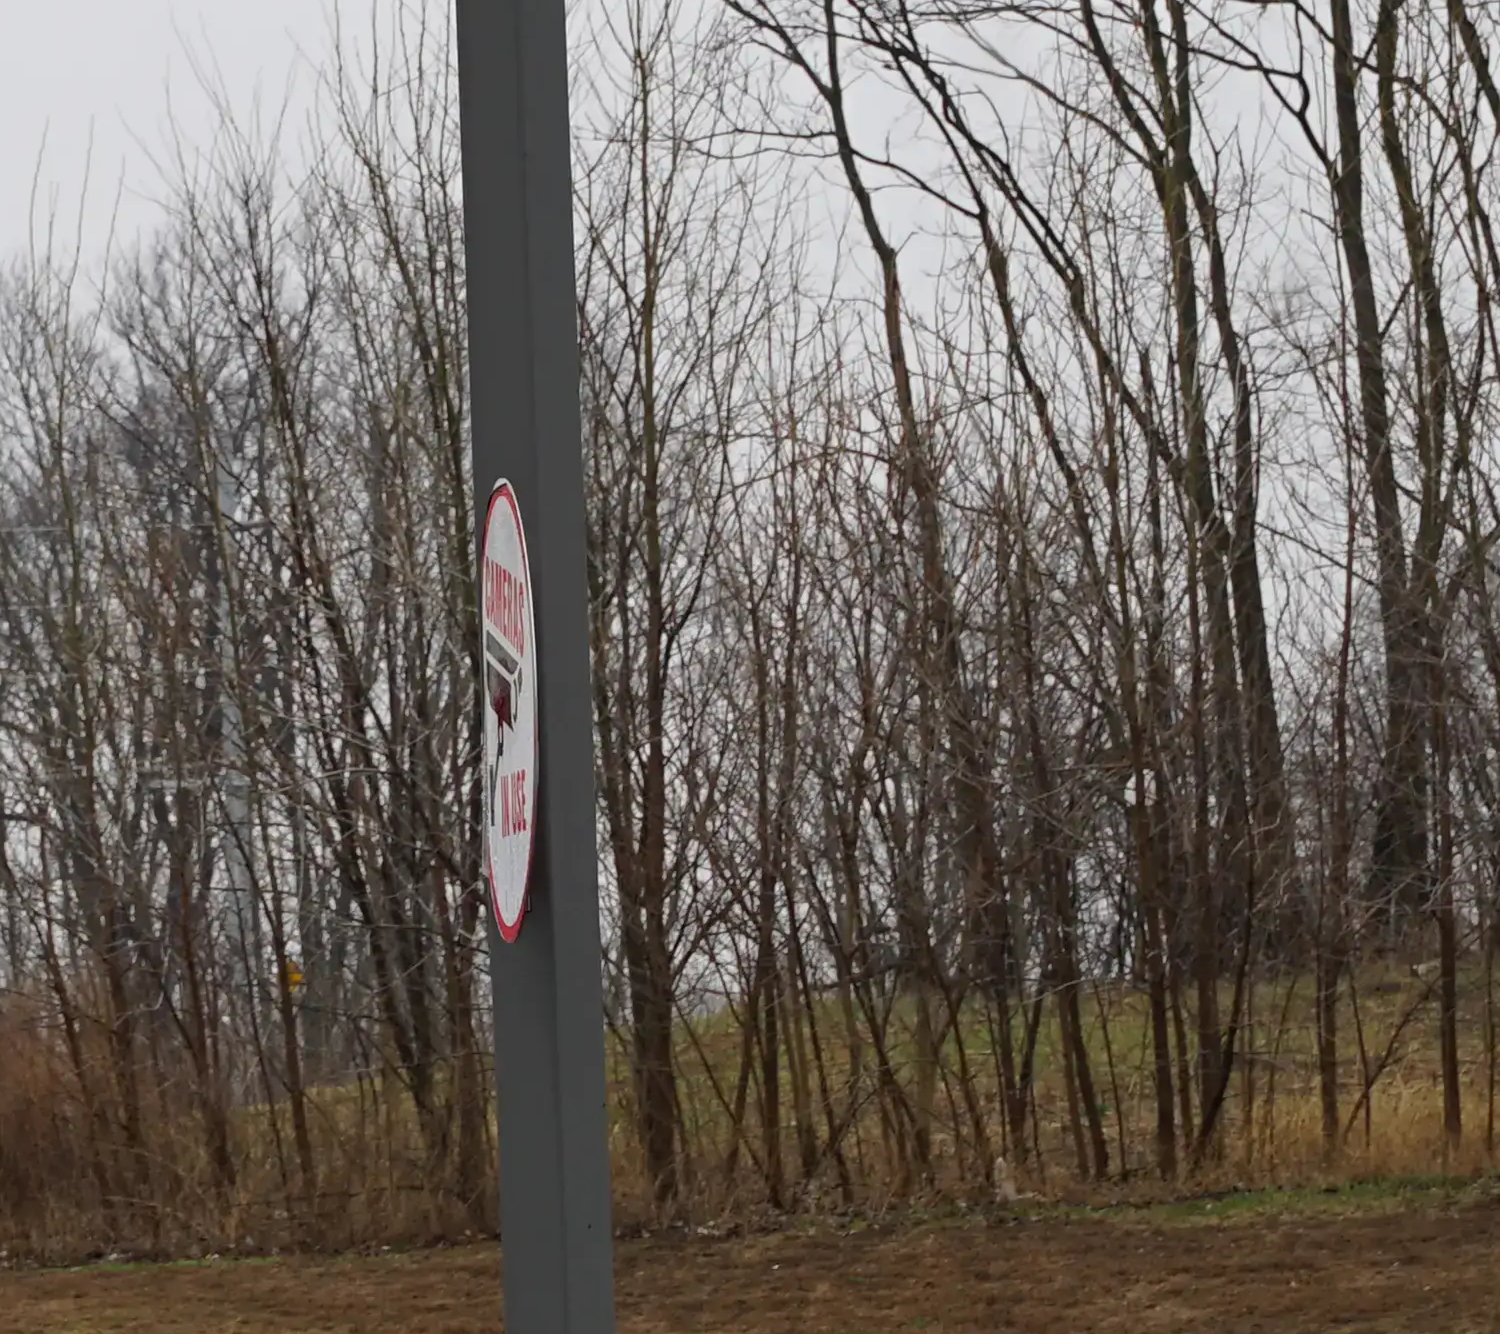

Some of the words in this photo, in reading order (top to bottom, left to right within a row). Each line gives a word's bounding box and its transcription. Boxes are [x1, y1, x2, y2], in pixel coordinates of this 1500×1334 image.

[485, 555, 525, 658] CAMERAS
[501, 774, 510, 838] IN
[511, 768, 527, 835] USE
